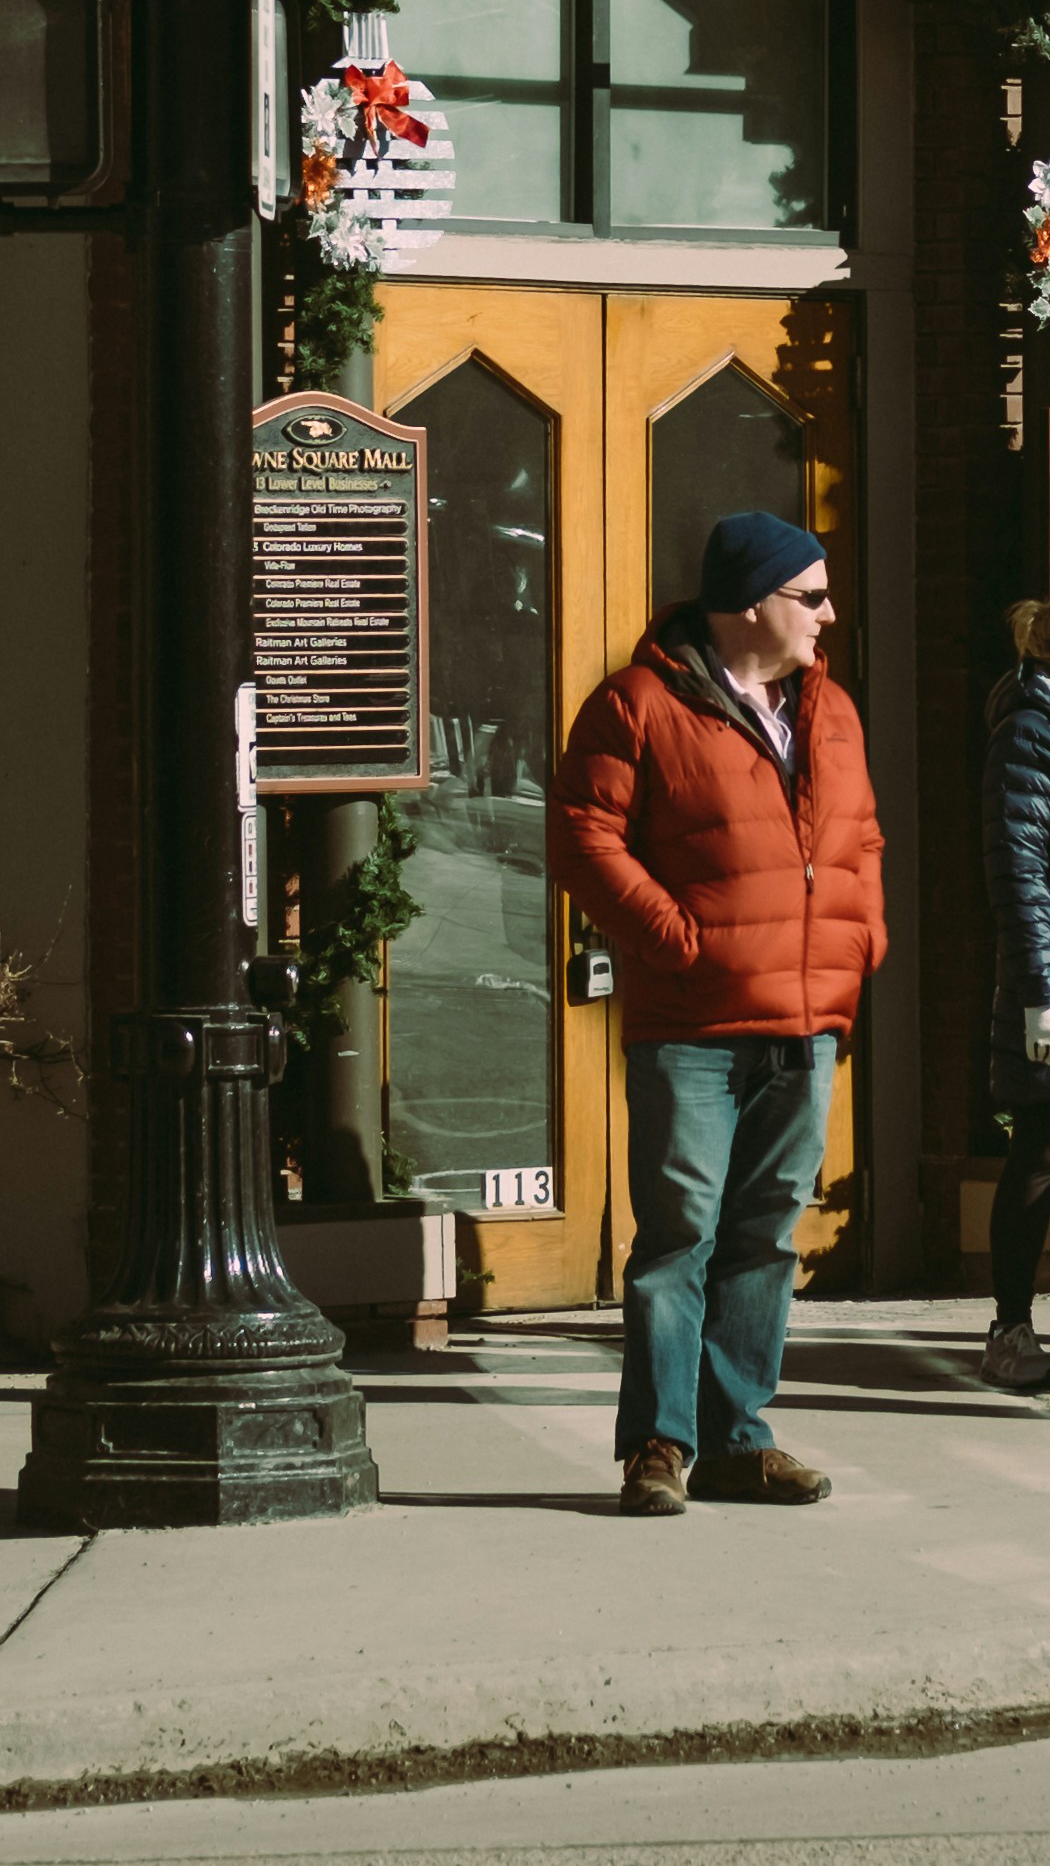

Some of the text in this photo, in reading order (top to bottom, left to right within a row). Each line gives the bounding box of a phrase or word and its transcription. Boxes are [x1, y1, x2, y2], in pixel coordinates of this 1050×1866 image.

[292, 447, 359, 472] SQUARE
[364, 448, 413, 469] MALL
[256, 476, 378, 490] 13 Lower Level Businesses
[254, 504, 402, 515] Breckenridge Old Time Photography
[263, 542, 301, 551] Colorado
[303, 542, 332, 553] Luxury
[334, 542, 363, 551] Homes
[255, 637, 347, 647] Raitman Art Galleries
[256, 655, 347, 666] Raitman Art Galleries
[492, 1170, 550, 1207] 113
